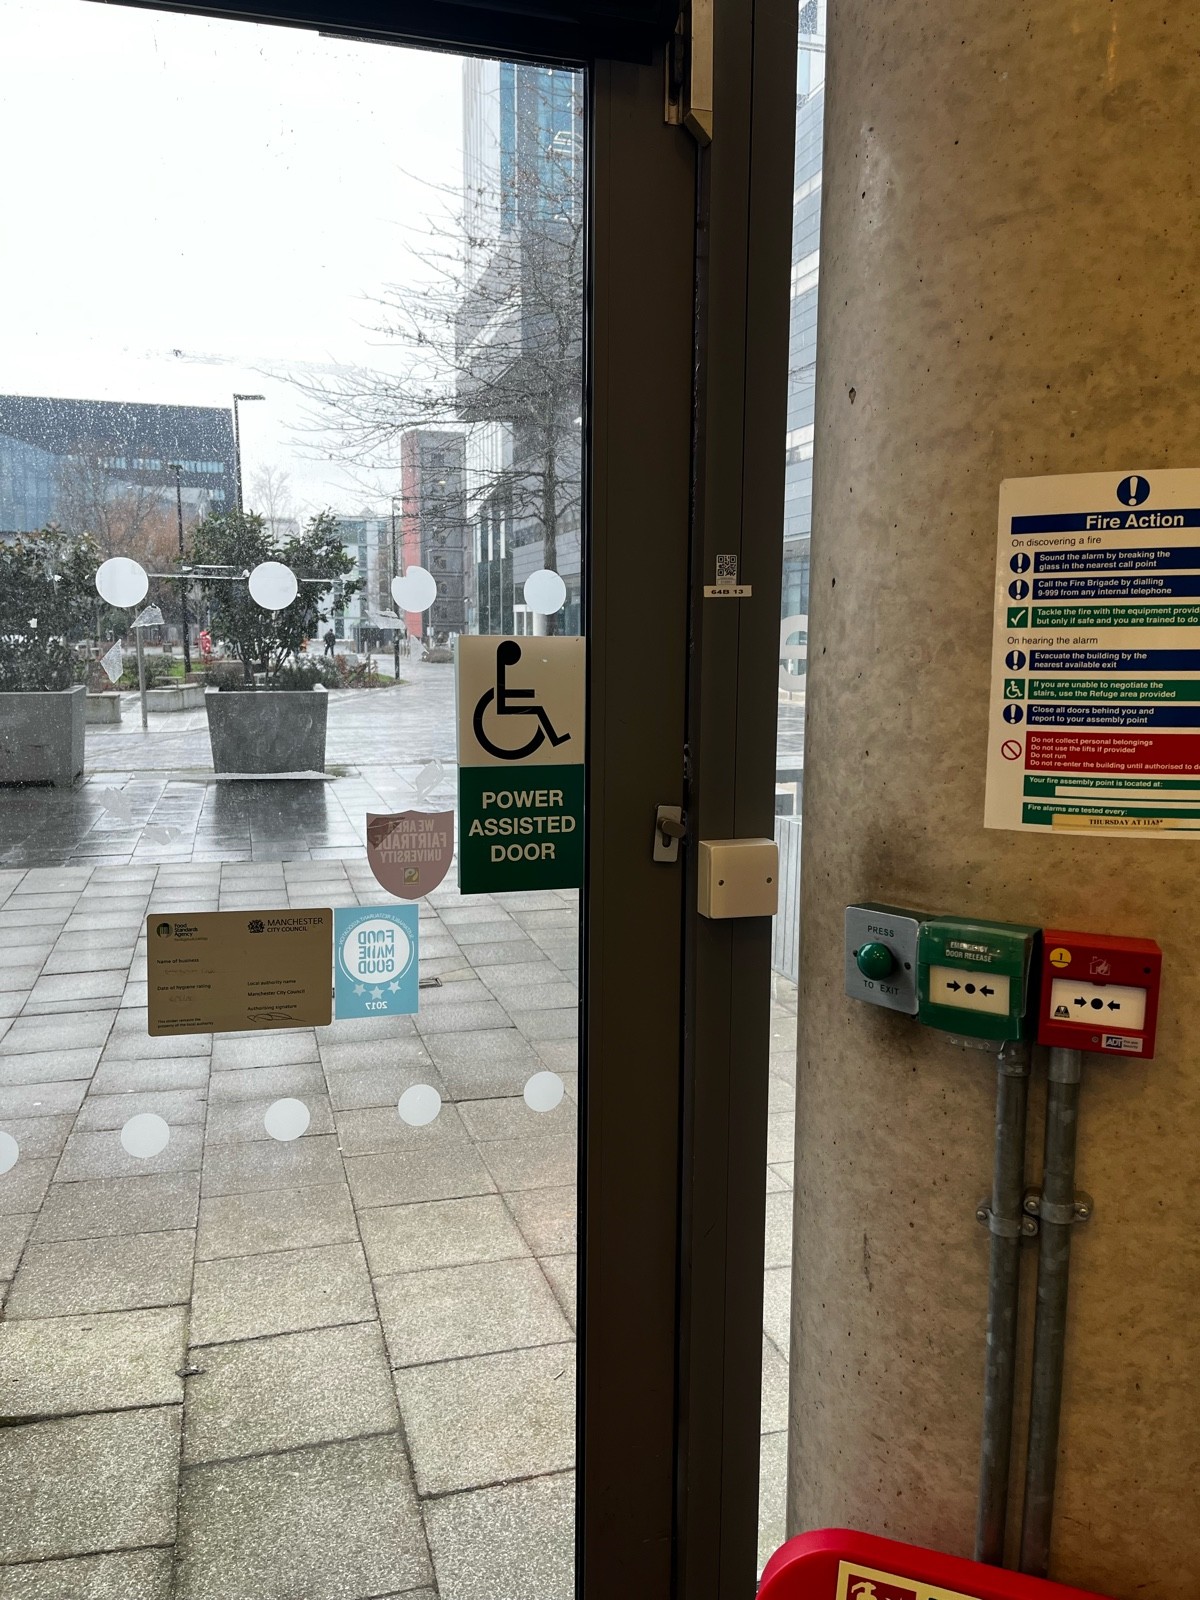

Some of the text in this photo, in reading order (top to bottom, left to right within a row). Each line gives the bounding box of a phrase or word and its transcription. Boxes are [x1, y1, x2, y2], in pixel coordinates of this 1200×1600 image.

[1086, 514, 1184, 529] Fire Action
[1012, 539, 1024, 547] On
[1027, 537, 1076, 548] discovering
[1087, 536, 1102, 544] fire
[1106, 552, 1116, 560] by
[1040, 563, 1060, 572] glass
[1136, 560, 1156, 568] point
[1088, 579, 1119, 588] Brigade
[1022, 637, 1054, 646] hearing
[482, 790, 563, 809] POWER
[468, 816, 576, 837] ASSISTED
[490, 843, 555, 862] DOOR
[267, 918, 324, 926] MANCHESTER
[868, 926, 894, 937] PRESS
[951, 942, 988, 952] EMEGECY
[946, 950, 992, 962] DOOR RELEASE
[864, 980, 899, 995] TO EXIT
[1106, 1038, 1122, 1047] ADT
